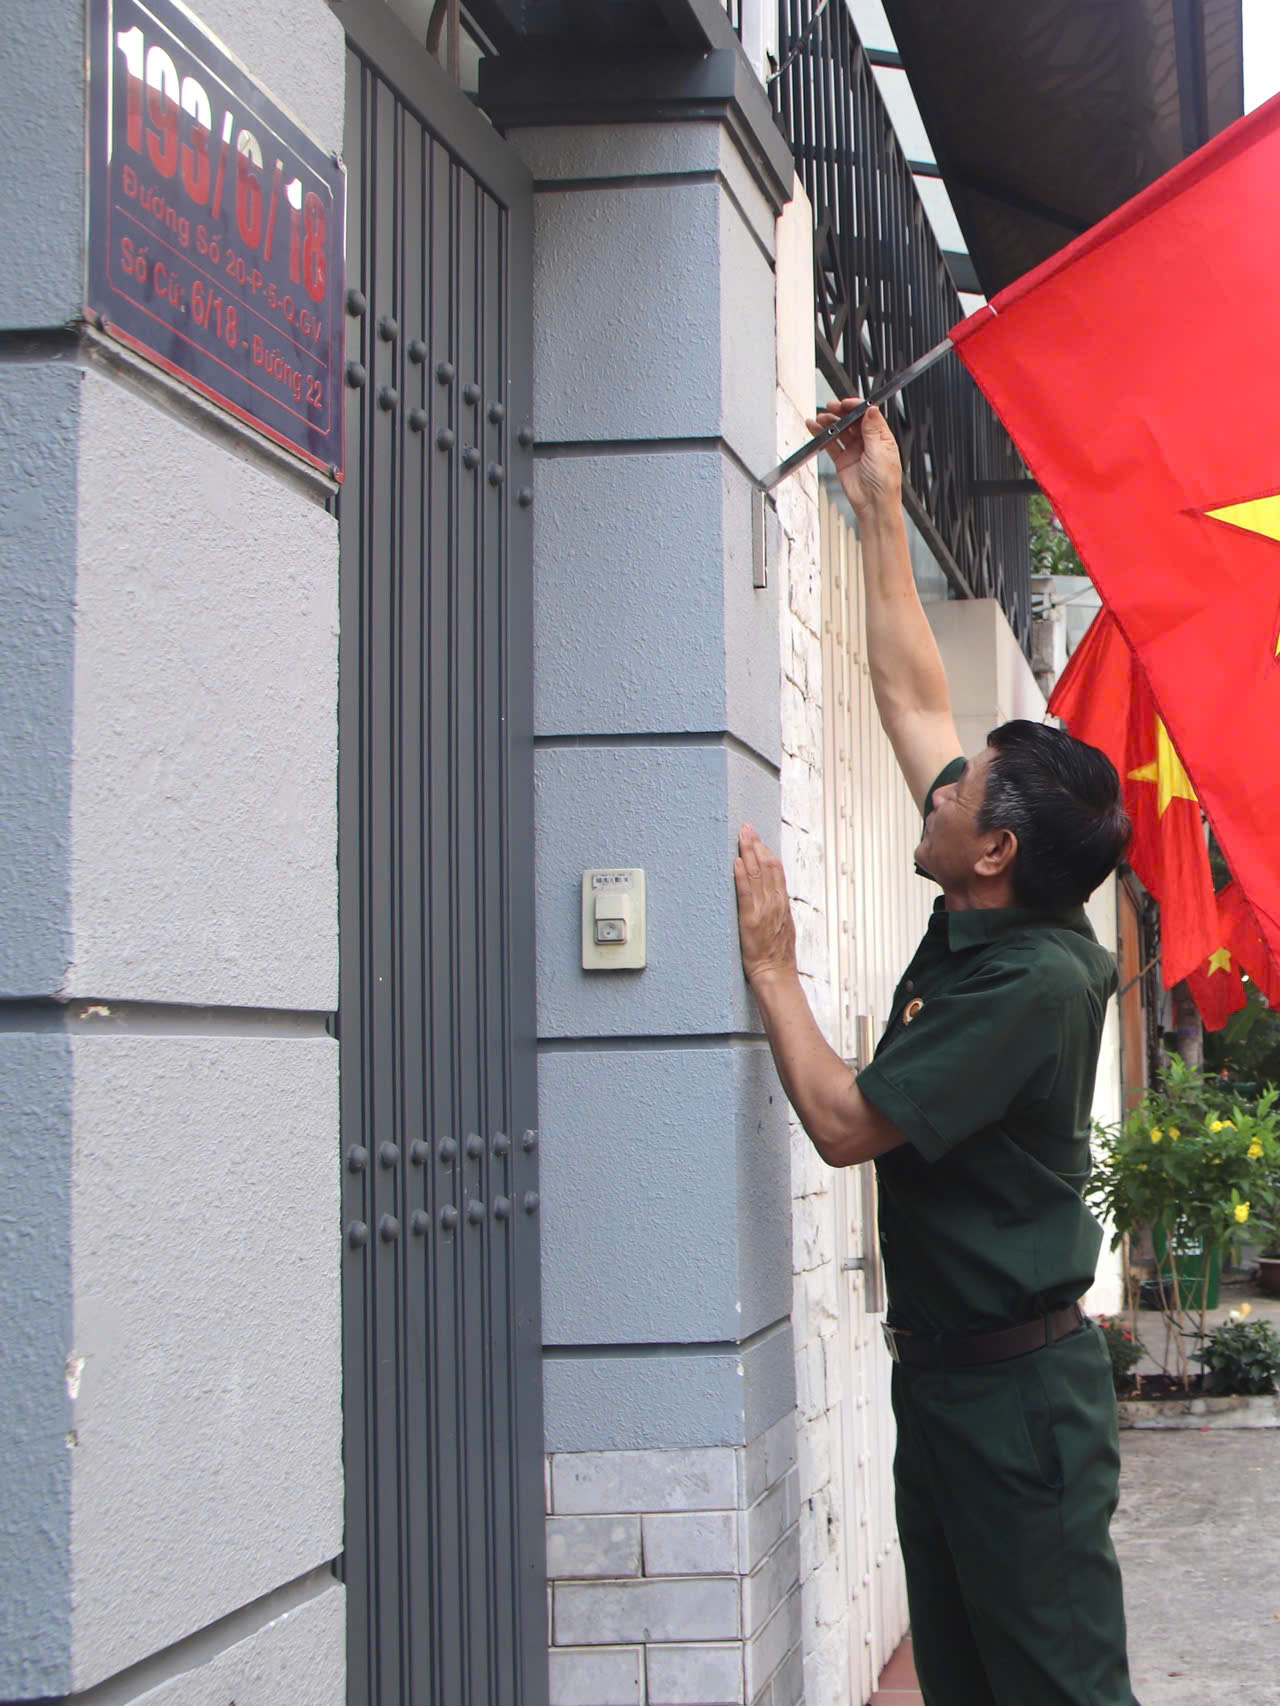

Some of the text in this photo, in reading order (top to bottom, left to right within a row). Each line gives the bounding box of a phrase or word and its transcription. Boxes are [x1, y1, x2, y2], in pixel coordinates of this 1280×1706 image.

[117, 26, 326, 303] 193/6/18
[195, 224, 223, 264] Số
[121, 237, 150, 283] Số
[192, 280, 238, 348] 6/18
[306, 375, 323, 409] 22
